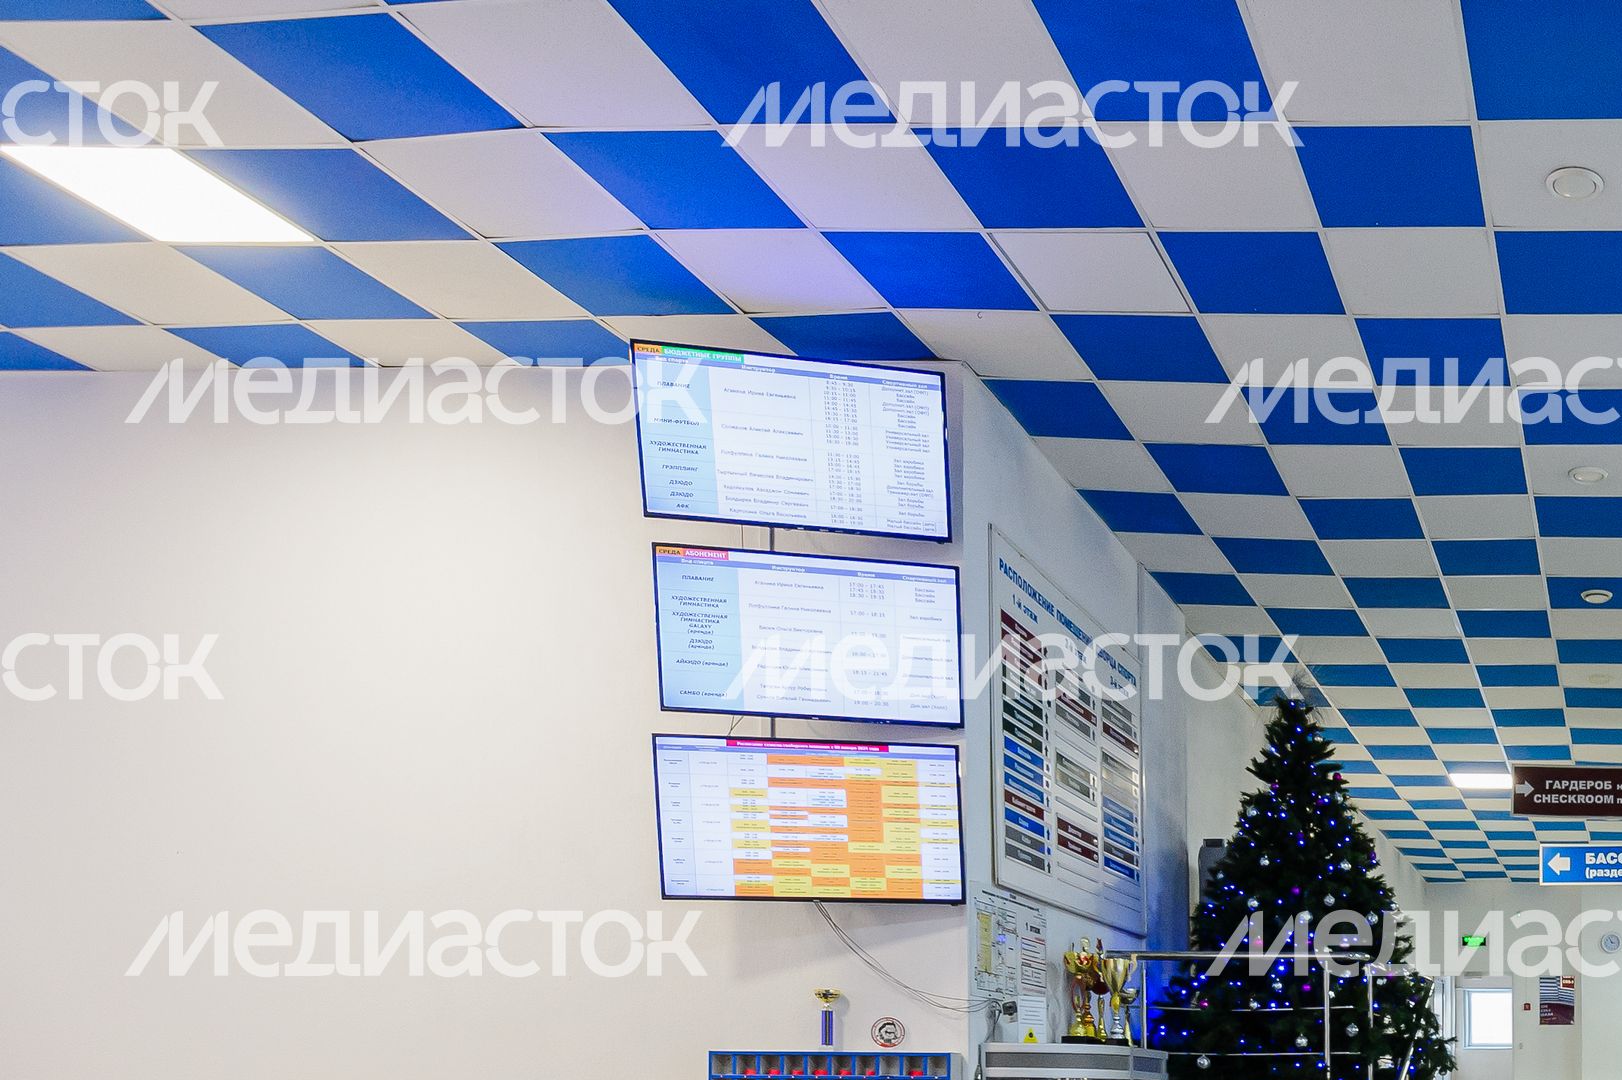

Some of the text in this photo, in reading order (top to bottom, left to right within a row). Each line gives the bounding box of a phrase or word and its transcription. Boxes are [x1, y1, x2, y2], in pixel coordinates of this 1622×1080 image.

[663, 348, 711, 358] БЮДЖЕТНЫЕ
[713, 353, 741, 362] ГРУППЫ
[649, 440, 706, 450] ХУДОЖЕСТВЕННАЯ
[658, 446, 698, 454] ГИМНАСТИКА
[685, 550, 725, 558] АБОНЕМЕНТ
[671, 595, 726, 603] ХУДОЖЕСТВЕННАЯ
[672, 611, 727, 619] ХУДОЖЕСТВЕННАЯ
[1023, 603, 1038, 624] этаж
[999, 557, 1054, 617] РАСПОЛОЖЕНИЕ
[1117, 662, 1136, 688] СПОРТА
[1545, 780, 1612, 791] ГАРДЕРОБ
[1534, 794, 1614, 804] CHECKROOM
